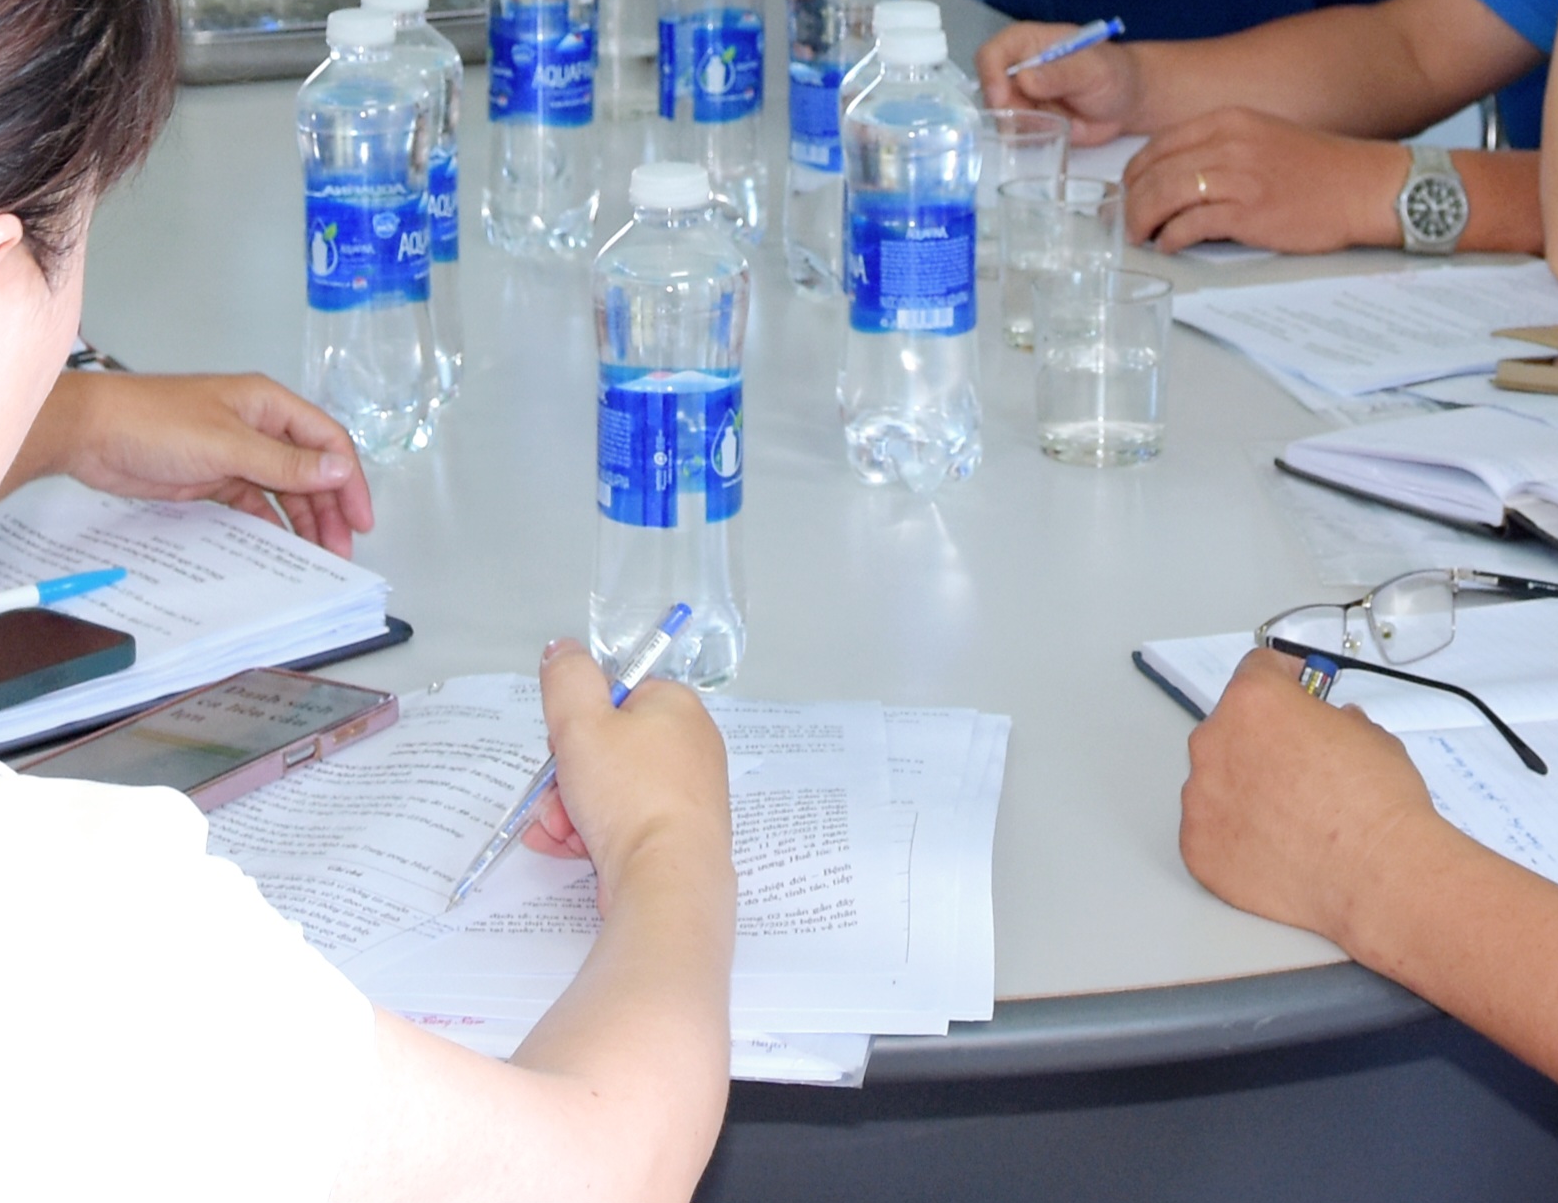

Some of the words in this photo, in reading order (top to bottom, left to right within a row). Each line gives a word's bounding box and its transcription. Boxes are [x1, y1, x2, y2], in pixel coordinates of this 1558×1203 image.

[224, 685, 281, 704] Danh
[758, 881, 785, 894] nhiệt
[823, 863, 852, 877] Bệnh
[832, 874, 853, 887] tiếp
[835, 898, 856, 910] đây
[800, 914, 826, 924] bệnh
[830, 910, 858, 921] nhân
